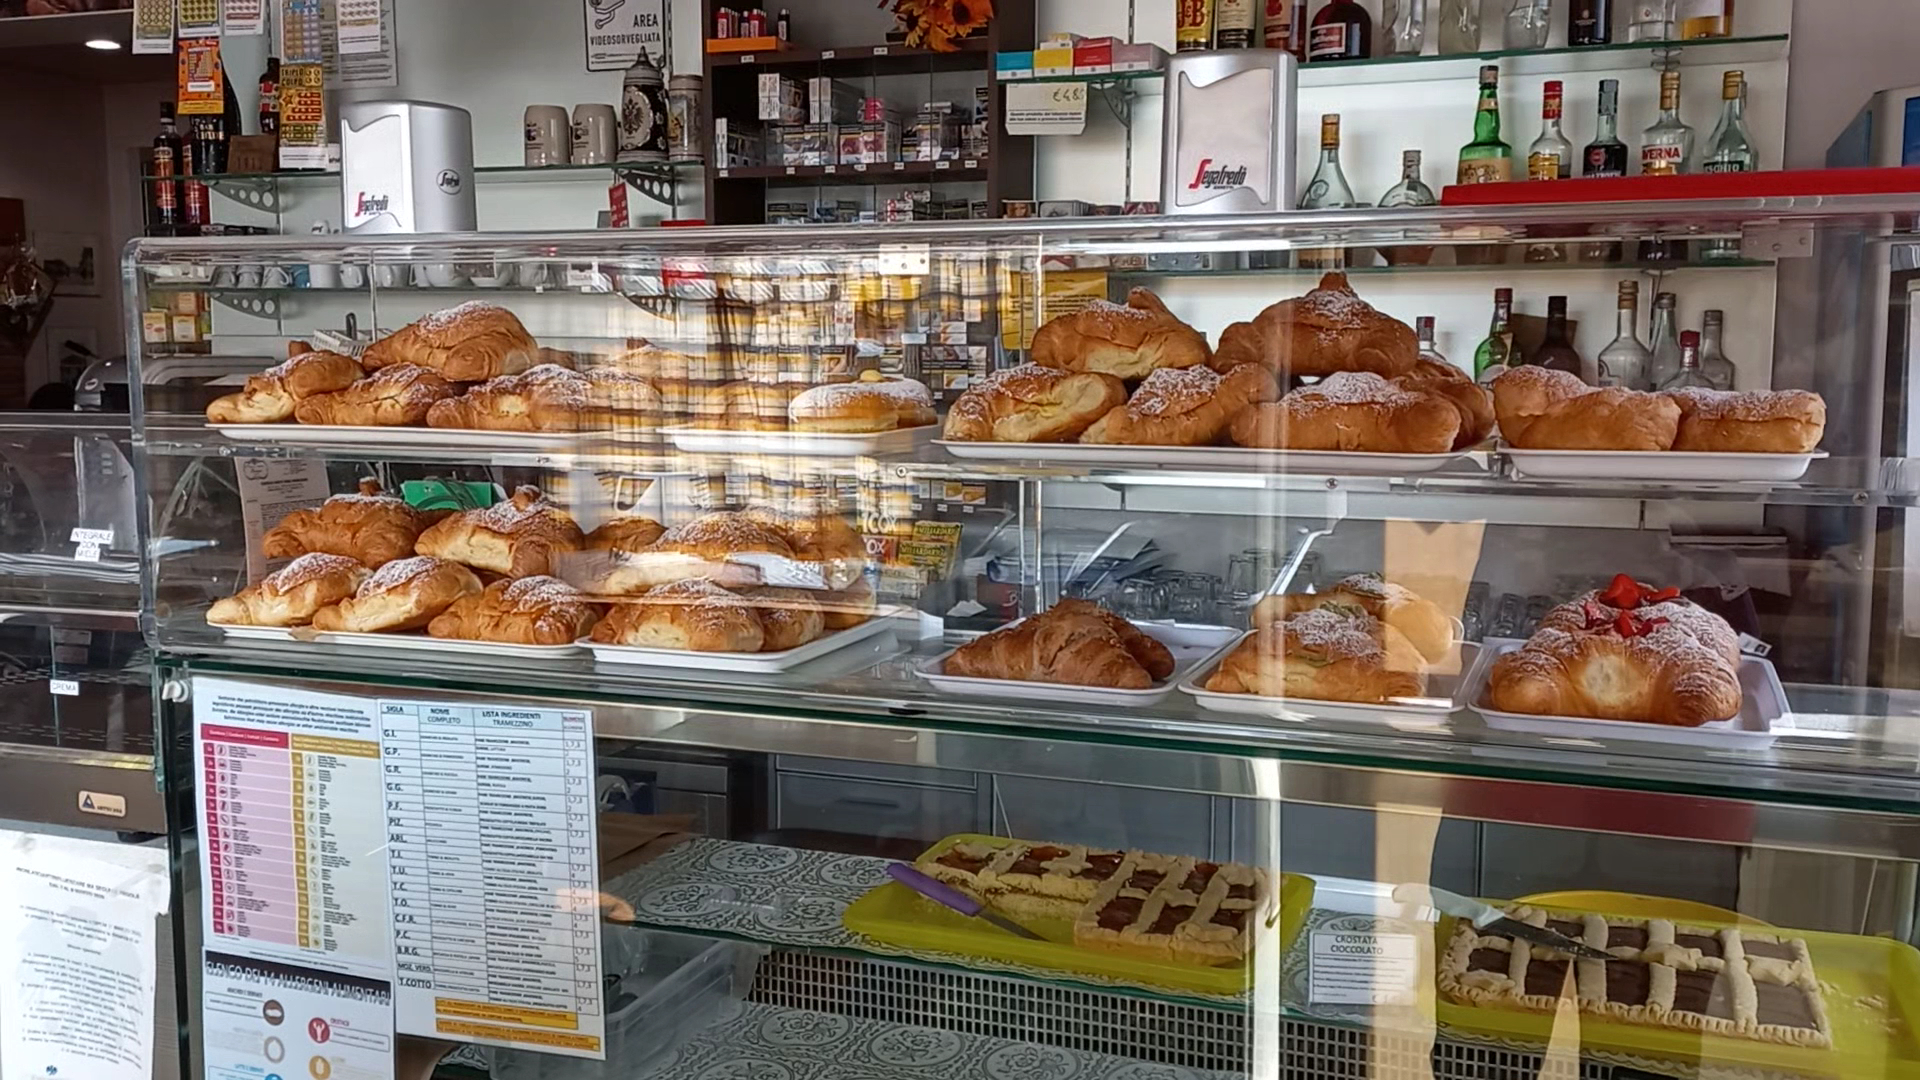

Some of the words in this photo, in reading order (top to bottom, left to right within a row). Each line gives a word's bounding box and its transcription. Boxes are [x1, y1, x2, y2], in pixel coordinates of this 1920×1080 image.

[633, 14, 659, 28] AREA
[590, 33, 661, 46] VIDEOSORVEGLIATA
[1188, 159, 1247, 189] Segafredo
[51, 682, 76, 692] CREMA
[386, 706, 404, 714] SIGLA
[430, 708, 450, 716] NOME
[482, 711, 500, 719] LISTA
[500, 711, 541, 720] INGREDIENTI
[427, 716, 461, 725] COMPLETO
[493, 719, 533, 728] TRAMEZZINO
[385, 747, 400, 756] G.P.
[387, 783, 403, 792] G.G.
[1335, 935, 1378, 945] CROSTATA
[1331, 945, 1383, 955] CIOCCOLATO
[205, 961, 242, 981] ELENCO
[277, 973, 331, 996] ALLERGENI
[332, 982, 391, 1007] ALIMENTARI
